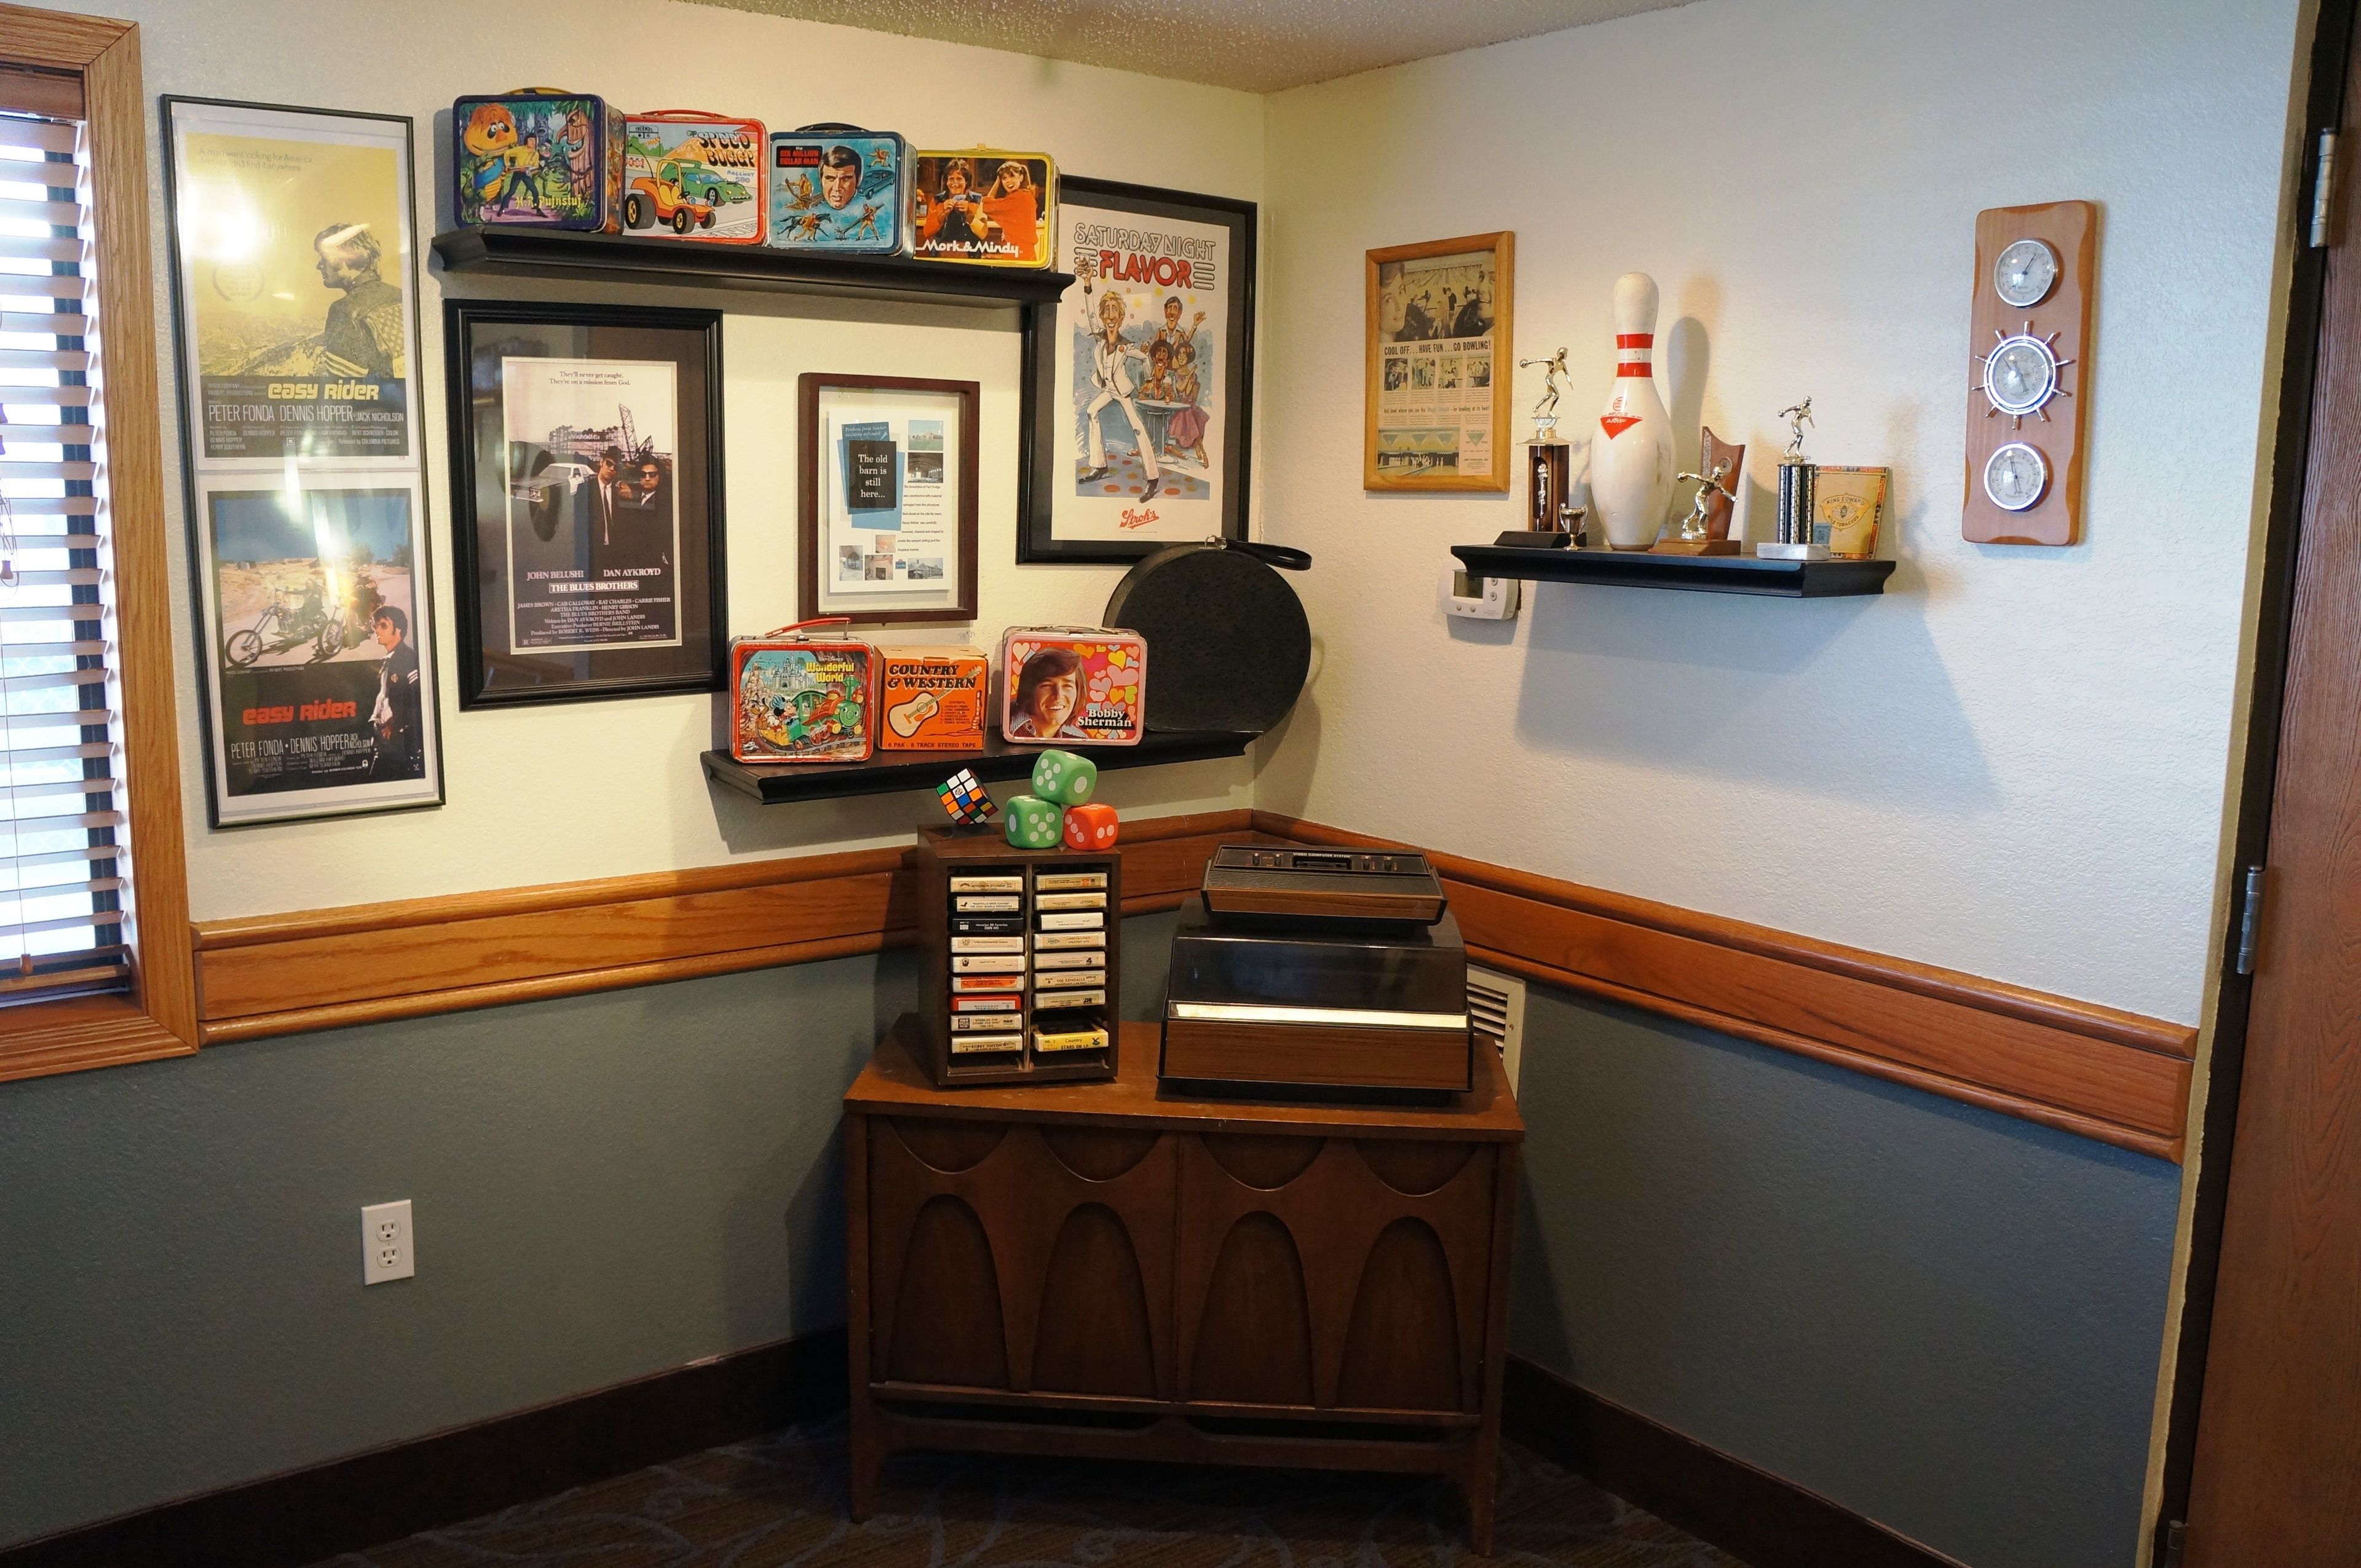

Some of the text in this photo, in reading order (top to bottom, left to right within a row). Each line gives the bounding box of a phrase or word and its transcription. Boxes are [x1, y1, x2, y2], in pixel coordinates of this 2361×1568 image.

[698, 132, 750, 149] SPEED
[245, 152, 271, 162] looking
[704, 149, 756, 168] BUGGY
[1074, 223, 1216, 261] SATURDAY NIGHT
[916, 238, 962, 251] Mork
[970, 240, 1019, 258] Mindy
[1099, 250, 1192, 289] FLAVOR
[1384, 346, 1398, 355] COOL
[1418, 344, 1431, 353] HAVE
[1433, 344, 1443, 353] FUN
[1463, 340, 1491, 352] BOWLING!
[267, 383, 318, 400] easy
[208, 405, 354, 422] PETER FONDA DENNIS HOPPER
[355, 412, 404, 422] JACK NICHOLSON
[858, 454, 888, 463] The old
[859, 465, 887, 475] barn is
[865, 478, 880, 486] still
[860, 489, 885, 498] here...
[1826, 496, 1864, 506] KING EDWARD
[526, 571, 549, 581] JOHN
[622, 568, 661, 577] AYKROYD
[595, 581, 638, 590] BROTHERS
[807, 662, 854, 673] Wonderful
[889, 664, 959, 676] COUNTRY
[816, 672, 844, 683] World
[887, 677, 976, 689] & WESTERN
[243, 706, 295, 725] easy
[1086, 709, 1125, 720] Bobby
[1077, 716, 1132, 727] Sherman
[231, 733, 349, 759] PETER FONDA DENNIS HOPPER
